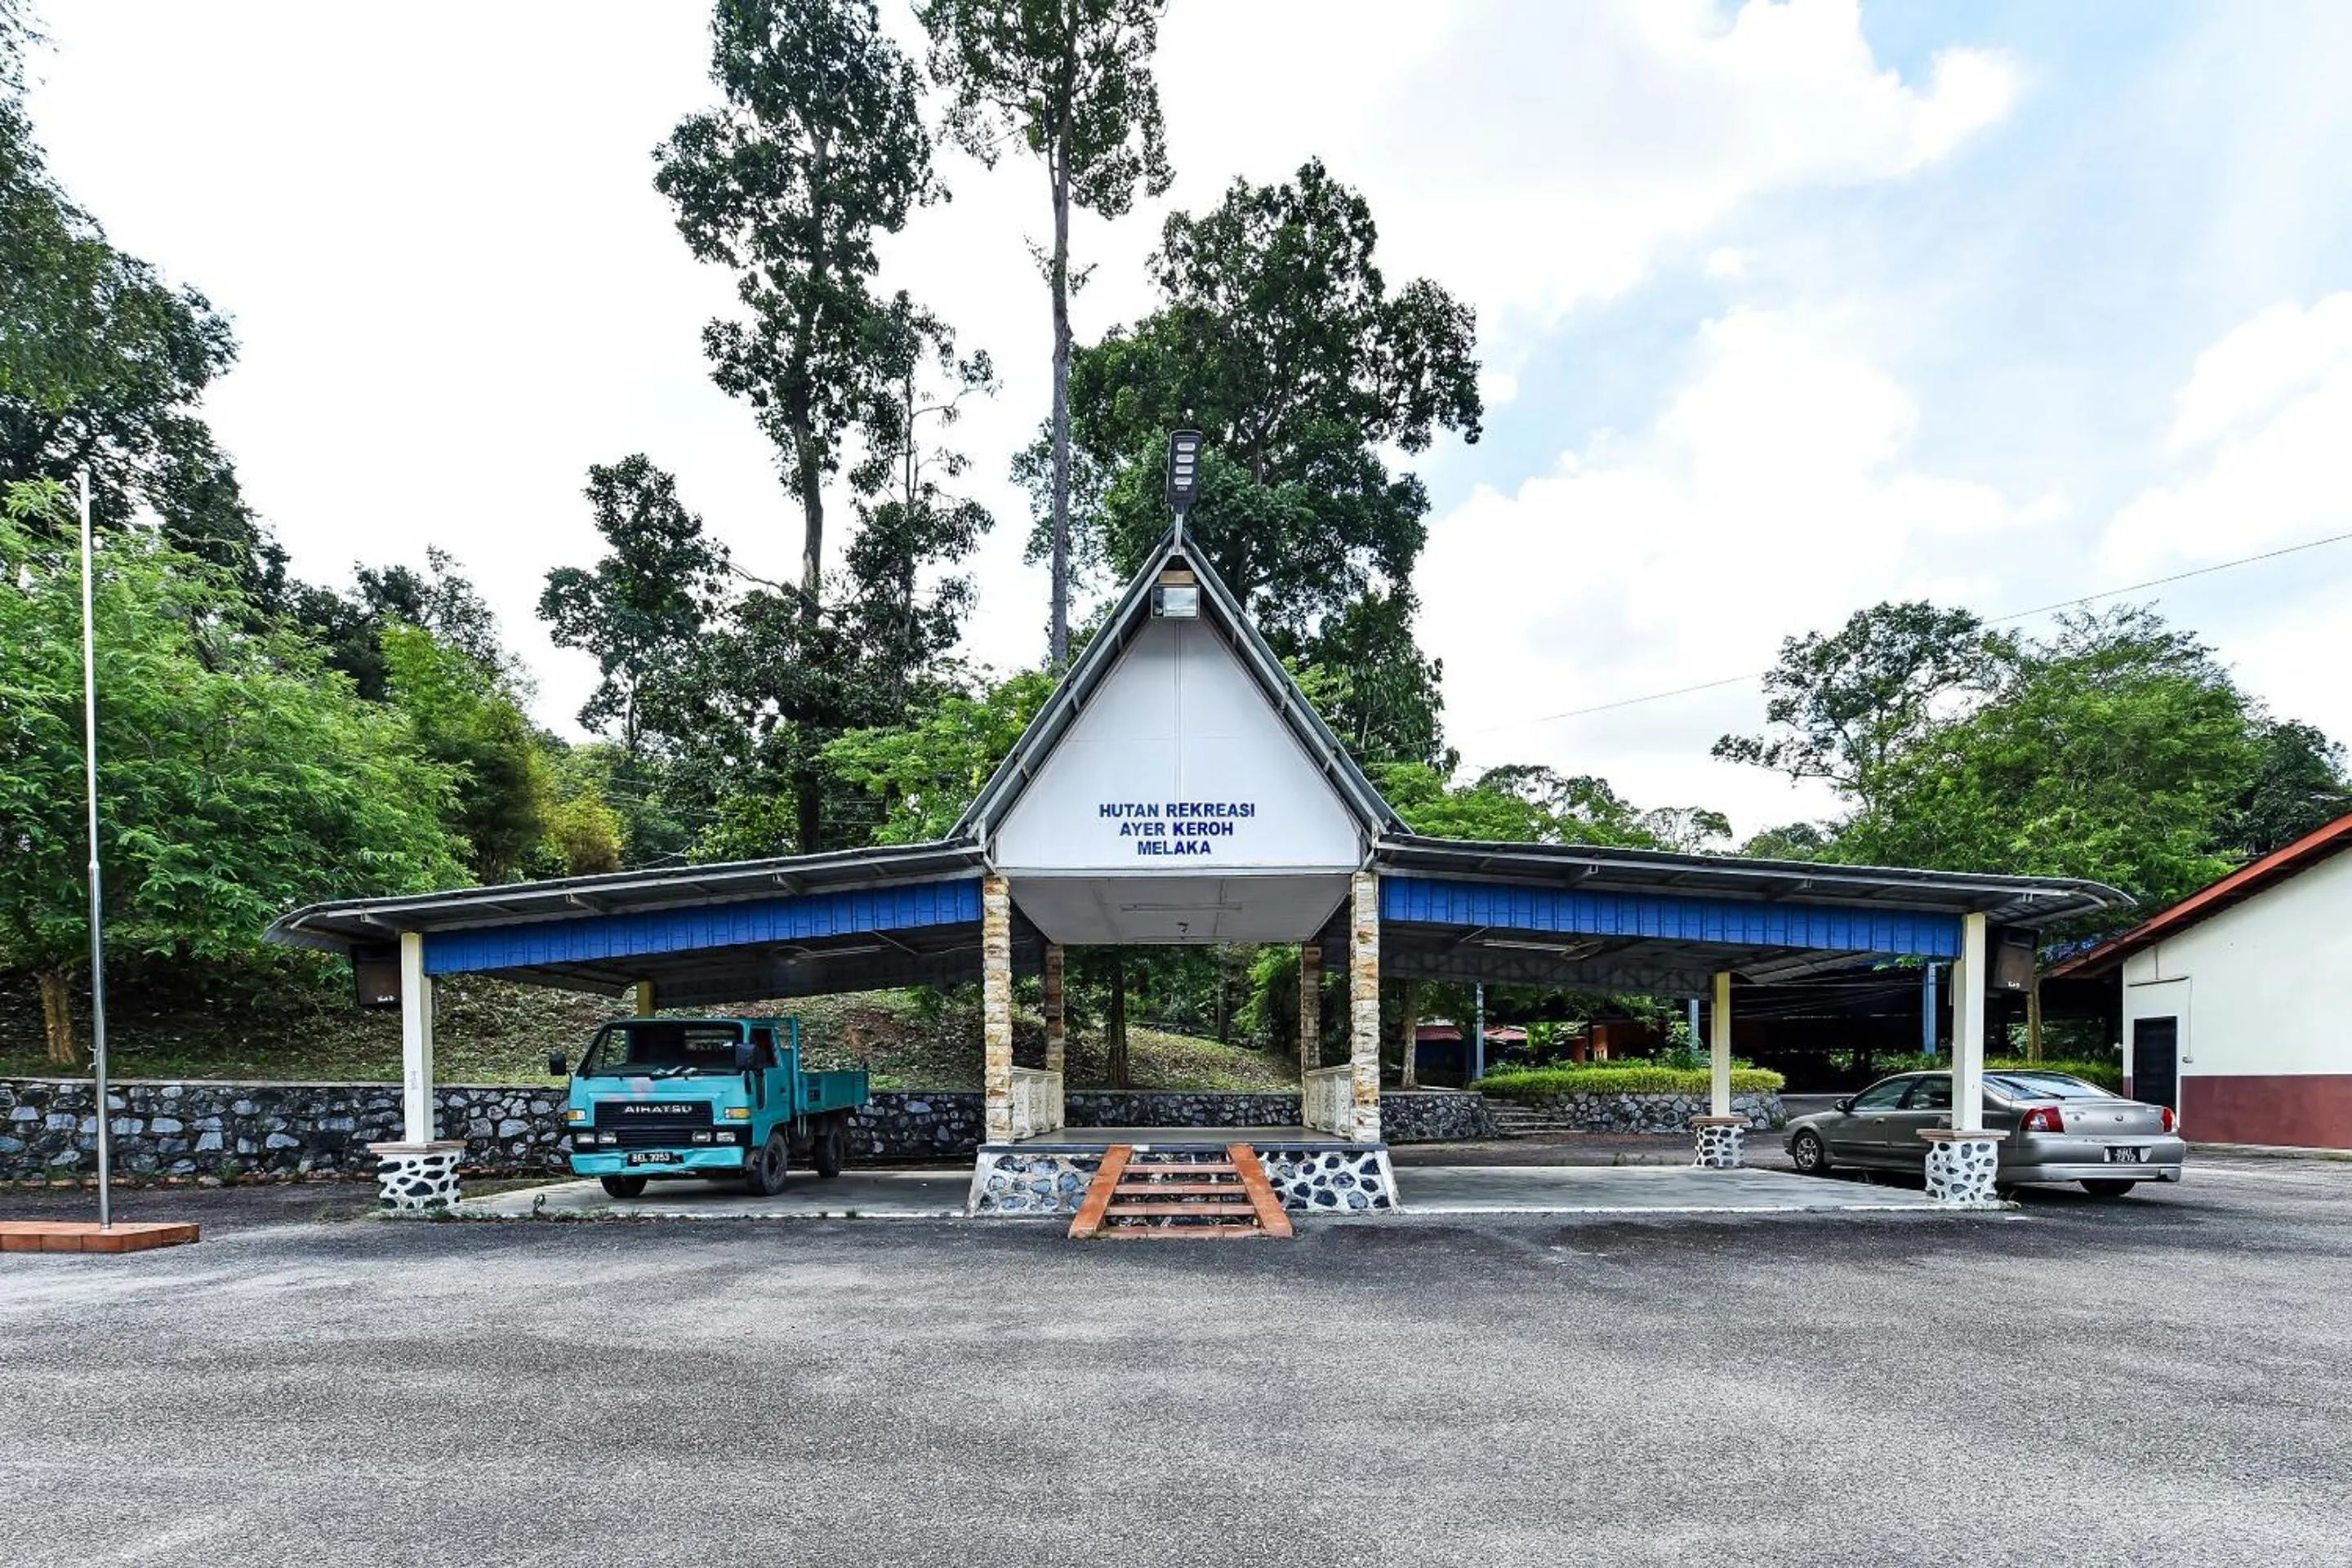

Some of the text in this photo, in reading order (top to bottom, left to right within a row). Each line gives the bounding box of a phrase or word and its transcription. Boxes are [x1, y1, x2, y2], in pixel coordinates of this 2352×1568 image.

[1099, 803, 1255, 817] HUTAN REKREASI
[1120, 822, 1233, 836] AYER KEROH
[1138, 840, 1211, 855] MELAKA
